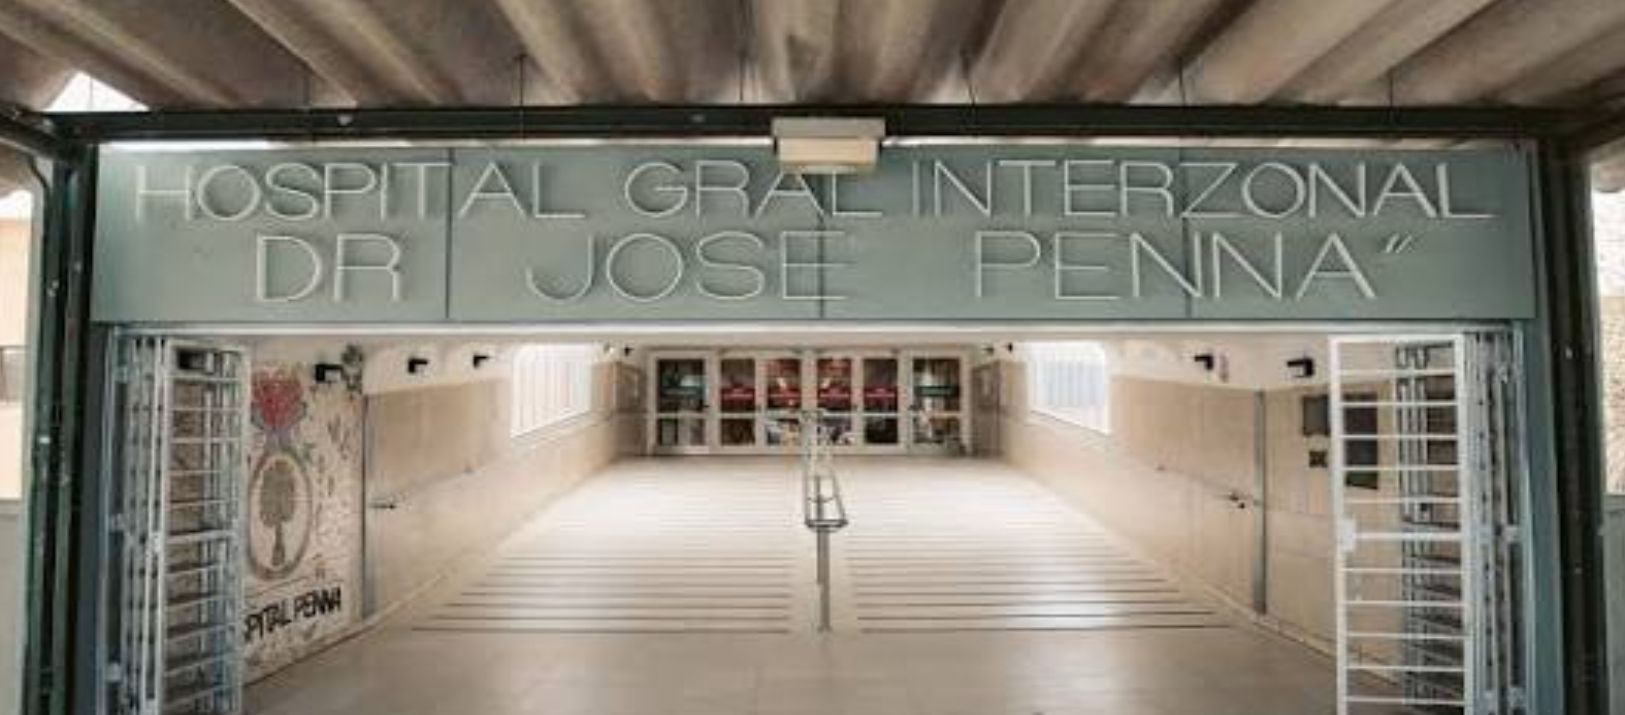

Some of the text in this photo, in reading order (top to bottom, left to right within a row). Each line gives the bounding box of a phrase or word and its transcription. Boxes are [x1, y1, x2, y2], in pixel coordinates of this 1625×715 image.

[135, 159, 1494, 221] HOSPITAL GRAL INTERZONAL
[255, 232, 401, 301] DR
[526, 231, 854, 301] JOSE
